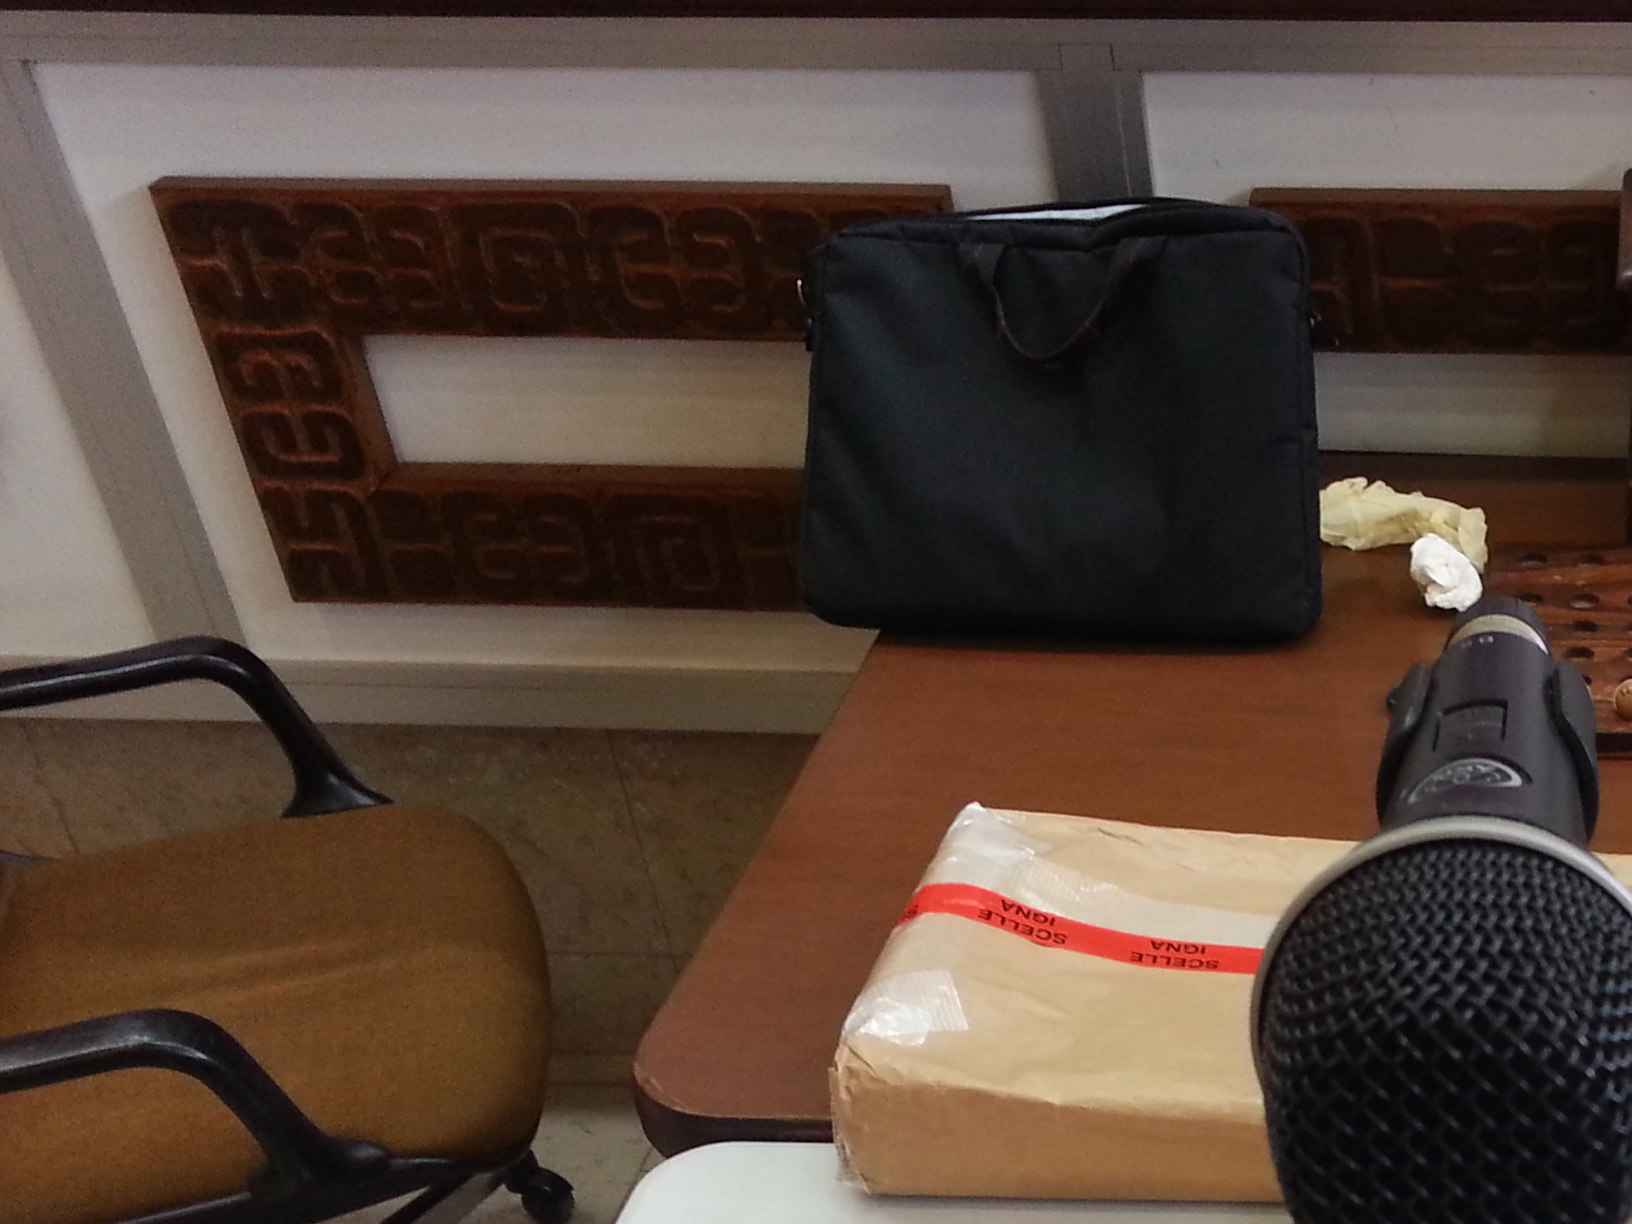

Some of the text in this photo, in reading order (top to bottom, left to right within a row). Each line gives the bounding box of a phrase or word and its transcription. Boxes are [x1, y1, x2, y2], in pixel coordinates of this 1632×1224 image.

[1000, 899, 1055, 926] IGNA
[978, 908, 1068, 945] SCELLE
[1150, 940, 1206, 955] IGNA
[1129, 951, 1219, 969] SCELLE
